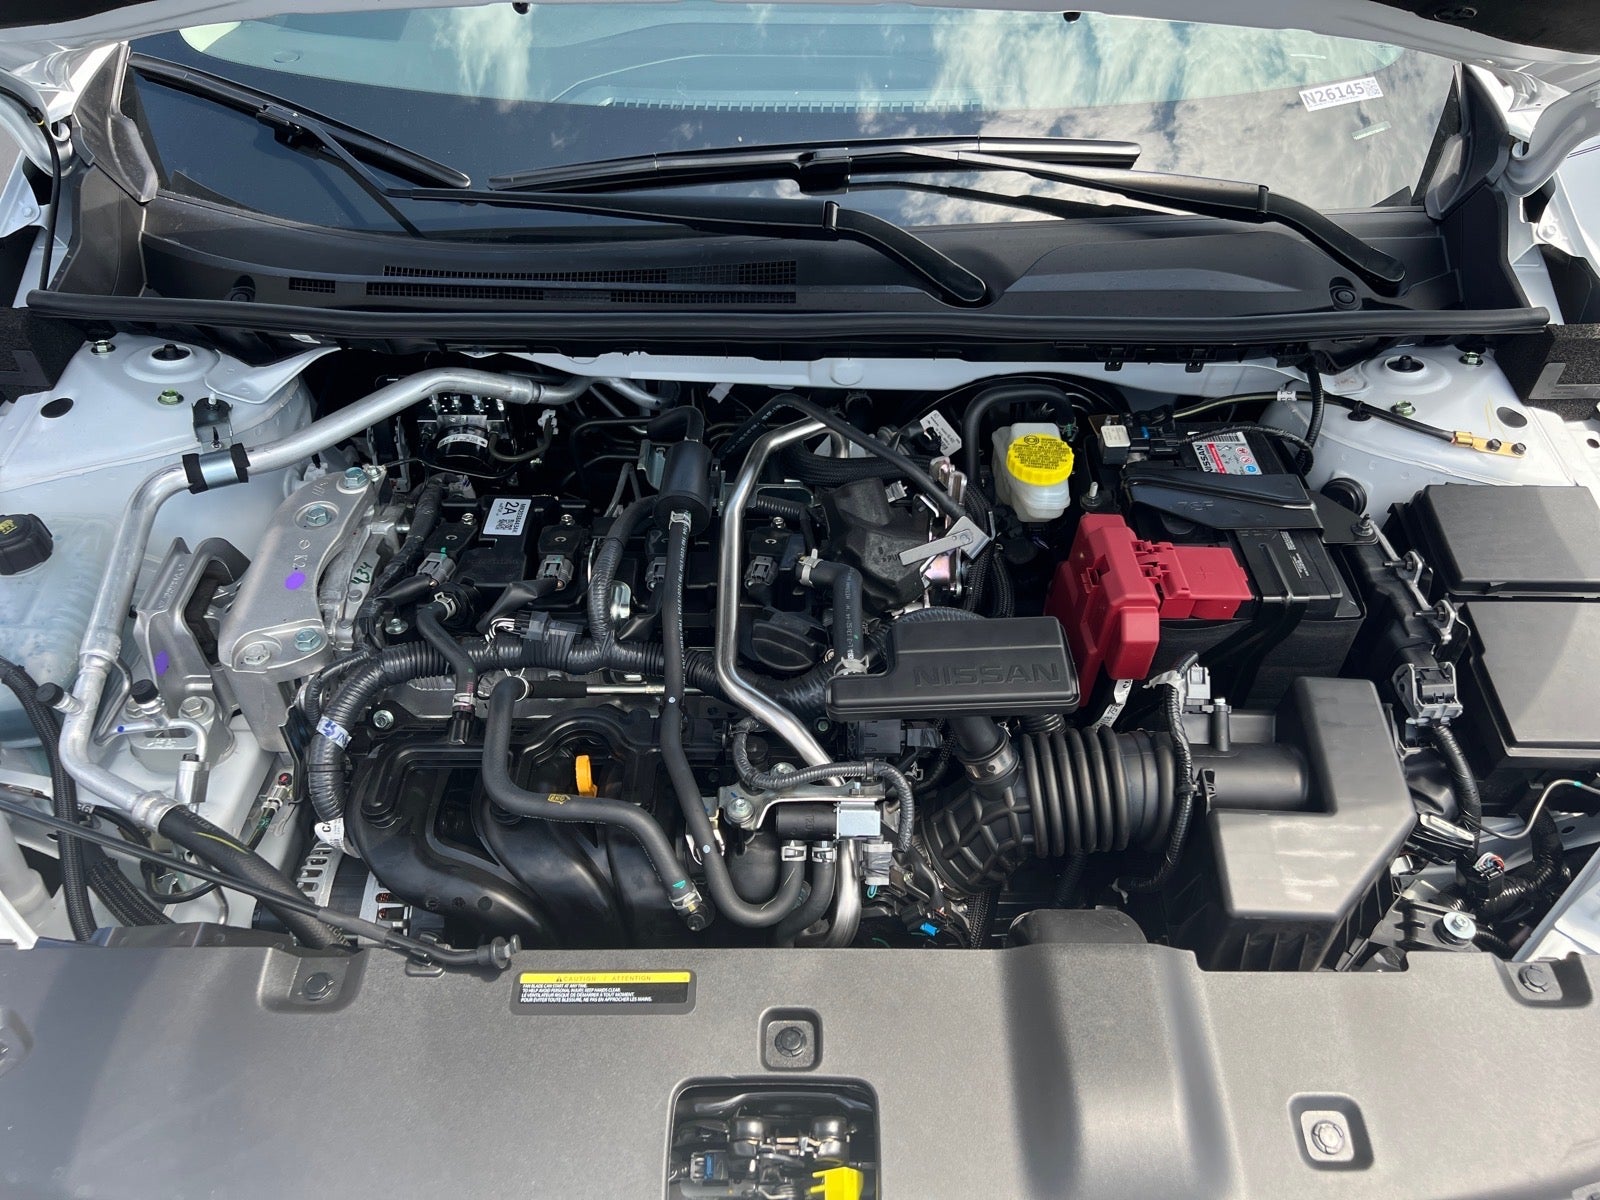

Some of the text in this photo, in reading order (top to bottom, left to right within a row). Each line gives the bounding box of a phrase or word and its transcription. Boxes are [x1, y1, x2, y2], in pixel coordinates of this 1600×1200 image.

[1303, 83, 1364, 105] N26145
[502, 502, 520, 516] 2A
[350, 561, 373, 585] 434
[913, 663, 1060, 687] NISSAN
